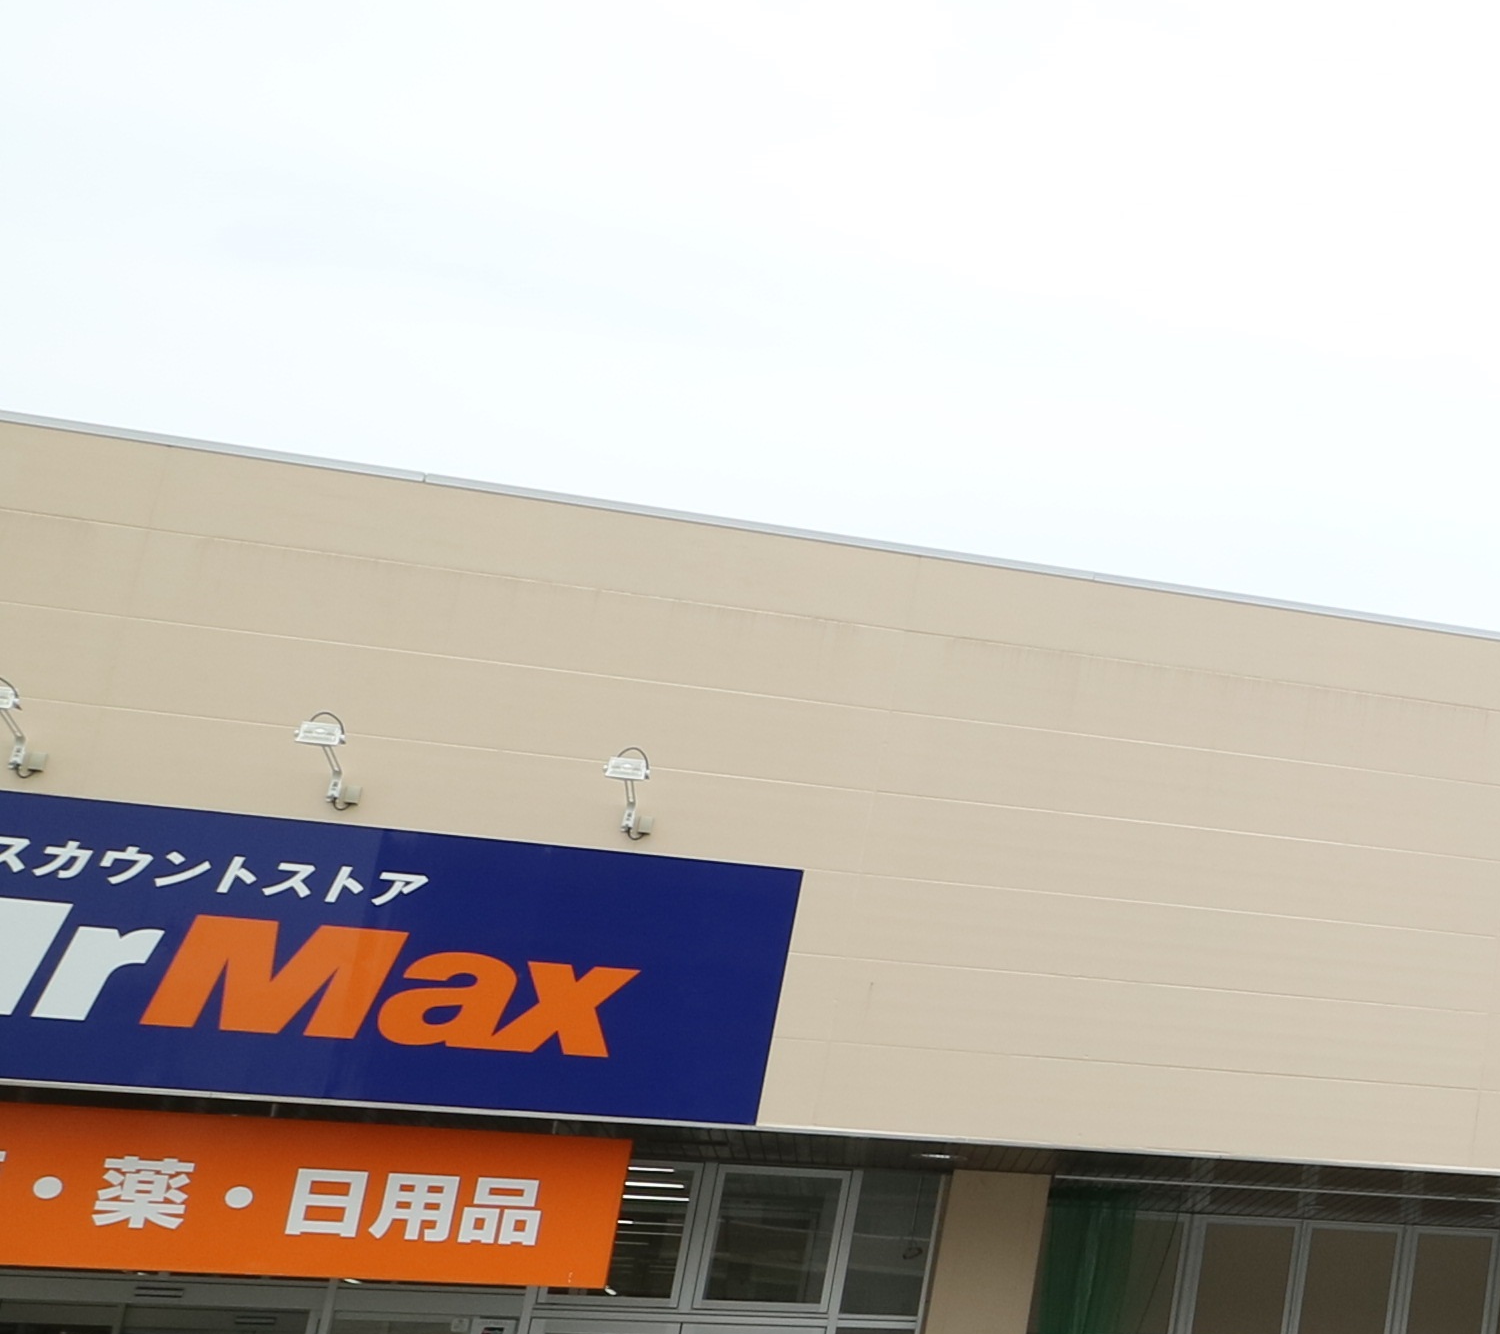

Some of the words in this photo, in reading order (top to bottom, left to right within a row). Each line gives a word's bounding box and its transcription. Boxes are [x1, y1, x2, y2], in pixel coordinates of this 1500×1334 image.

[0, 897, 641, 1058] rMax
[0, 1150, 543, 1247] ・薬・日用品
